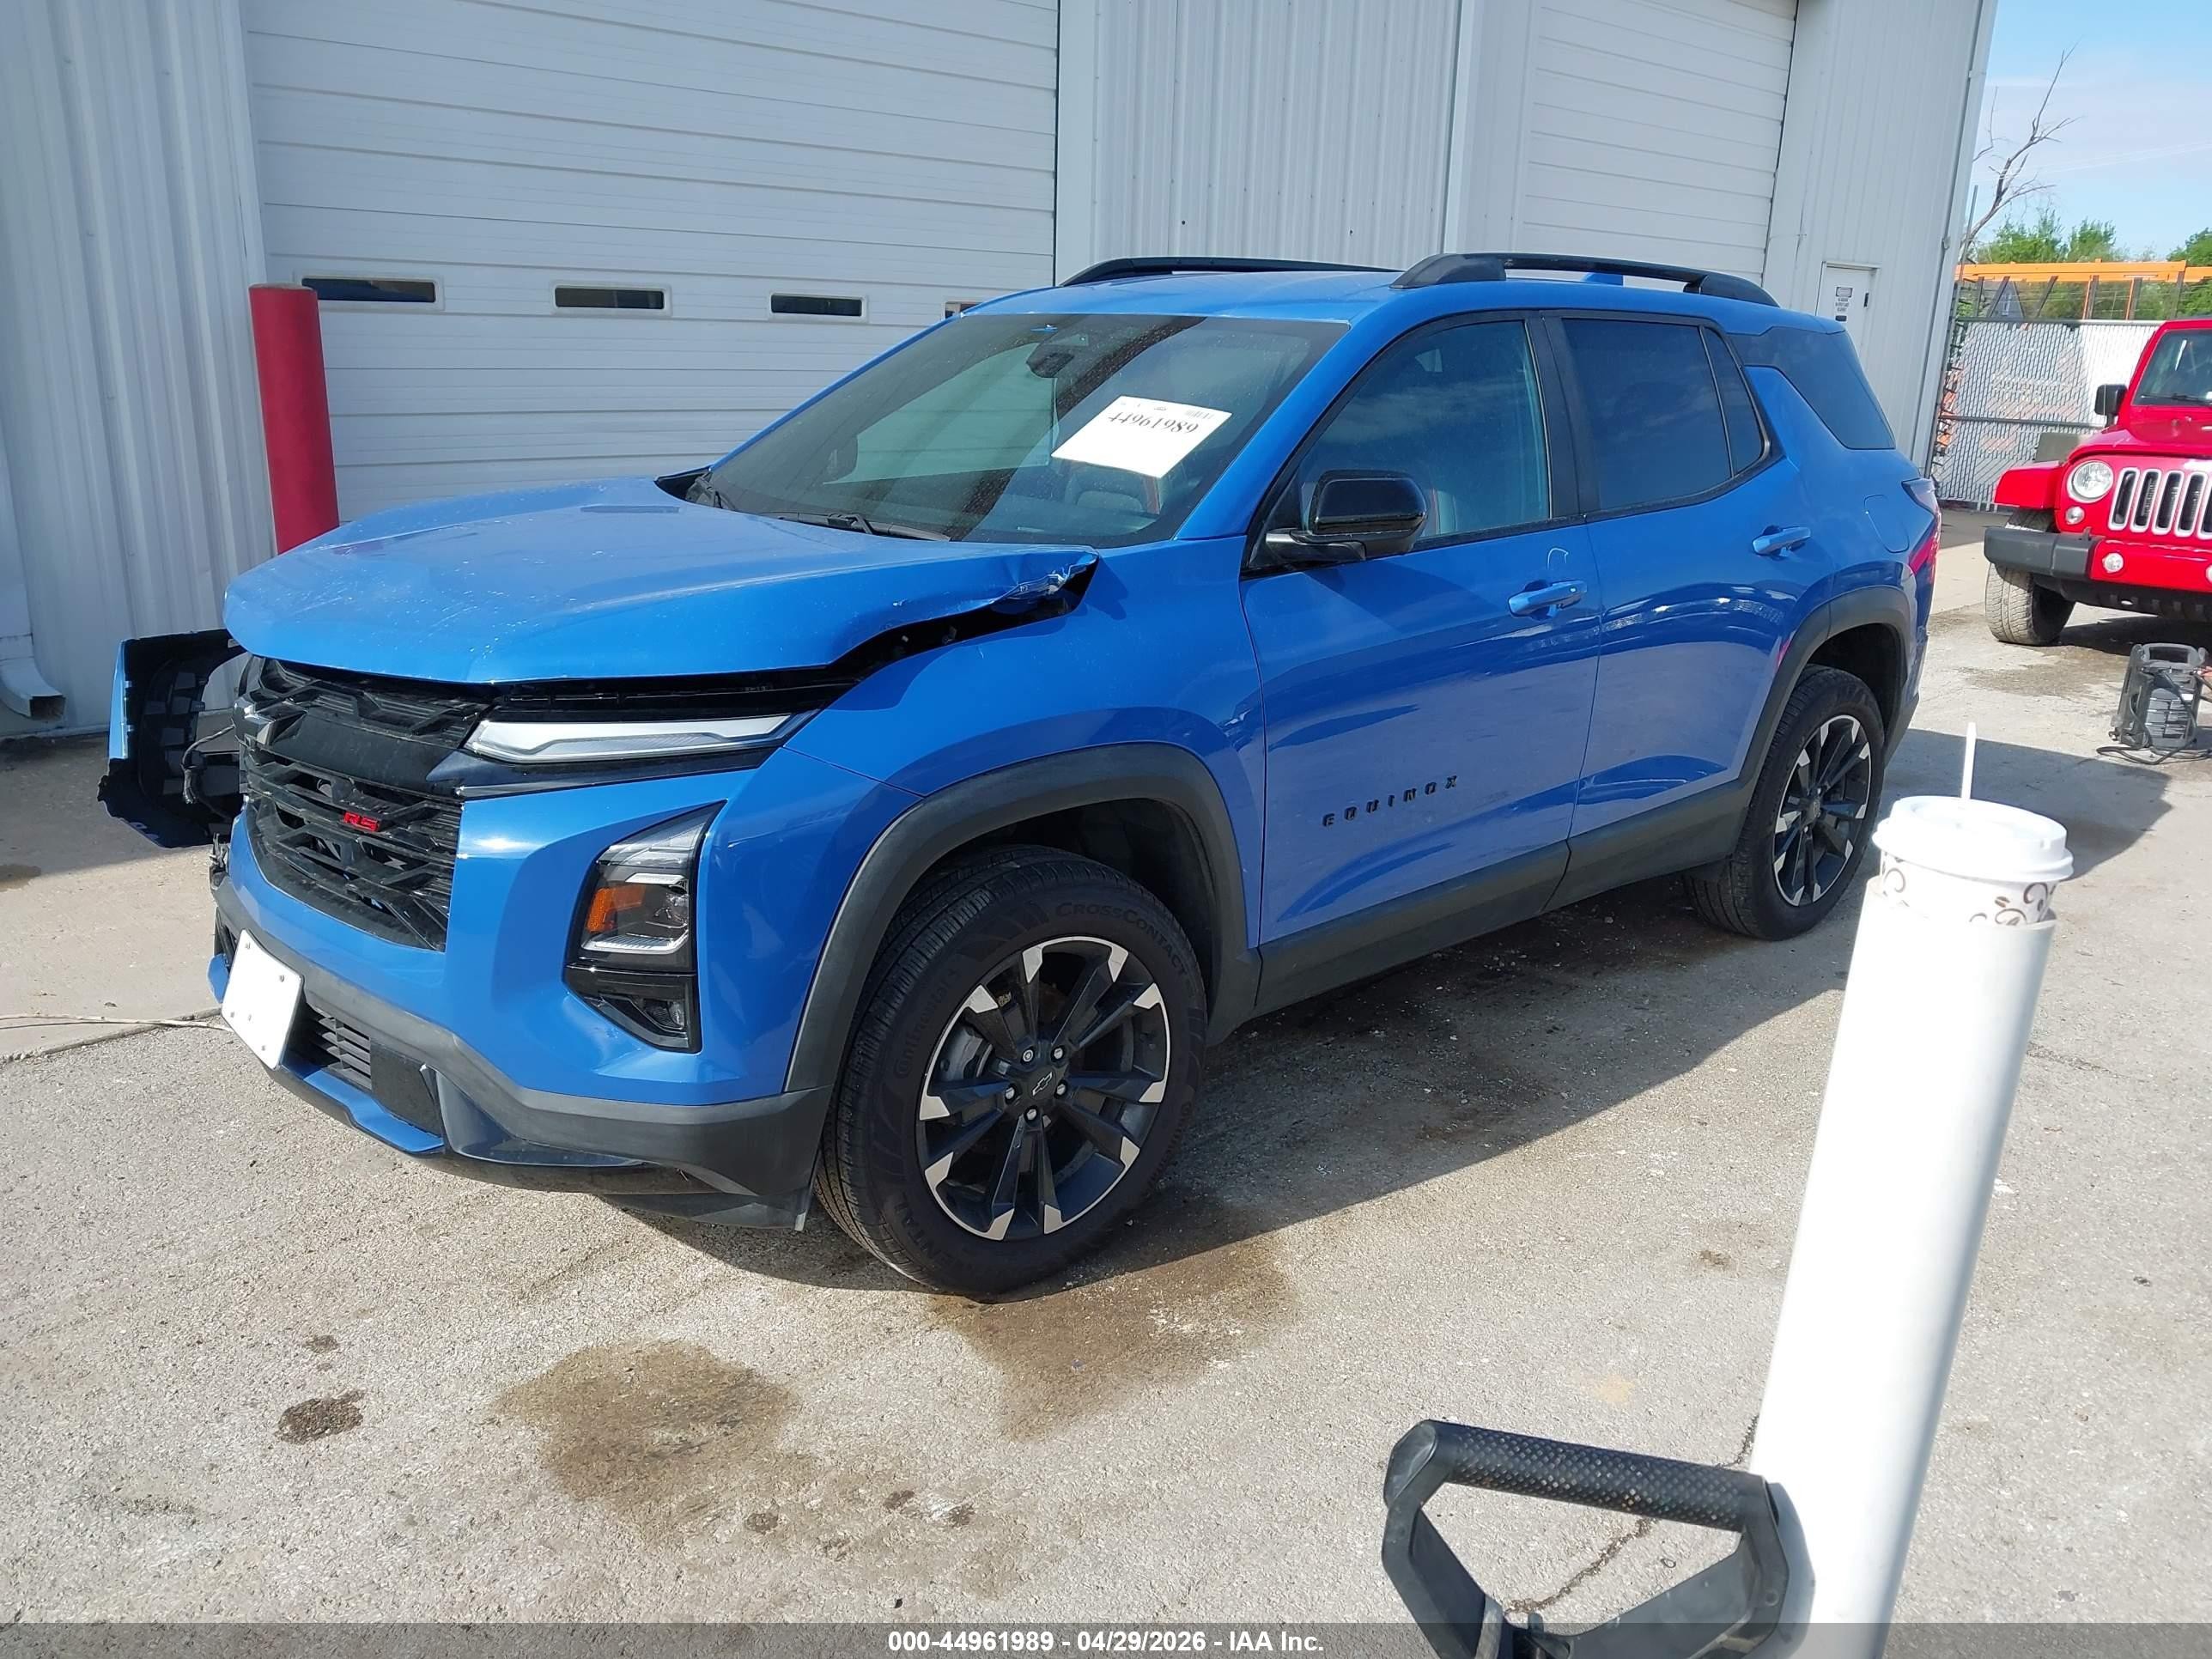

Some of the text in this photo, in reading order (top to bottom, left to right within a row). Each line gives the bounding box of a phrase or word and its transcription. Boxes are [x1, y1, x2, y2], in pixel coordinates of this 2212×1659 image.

[1108, 411, 1200, 434] 44961989
[1322, 775, 1458, 827] EQUINOX
[343, 811, 379, 831] RS
